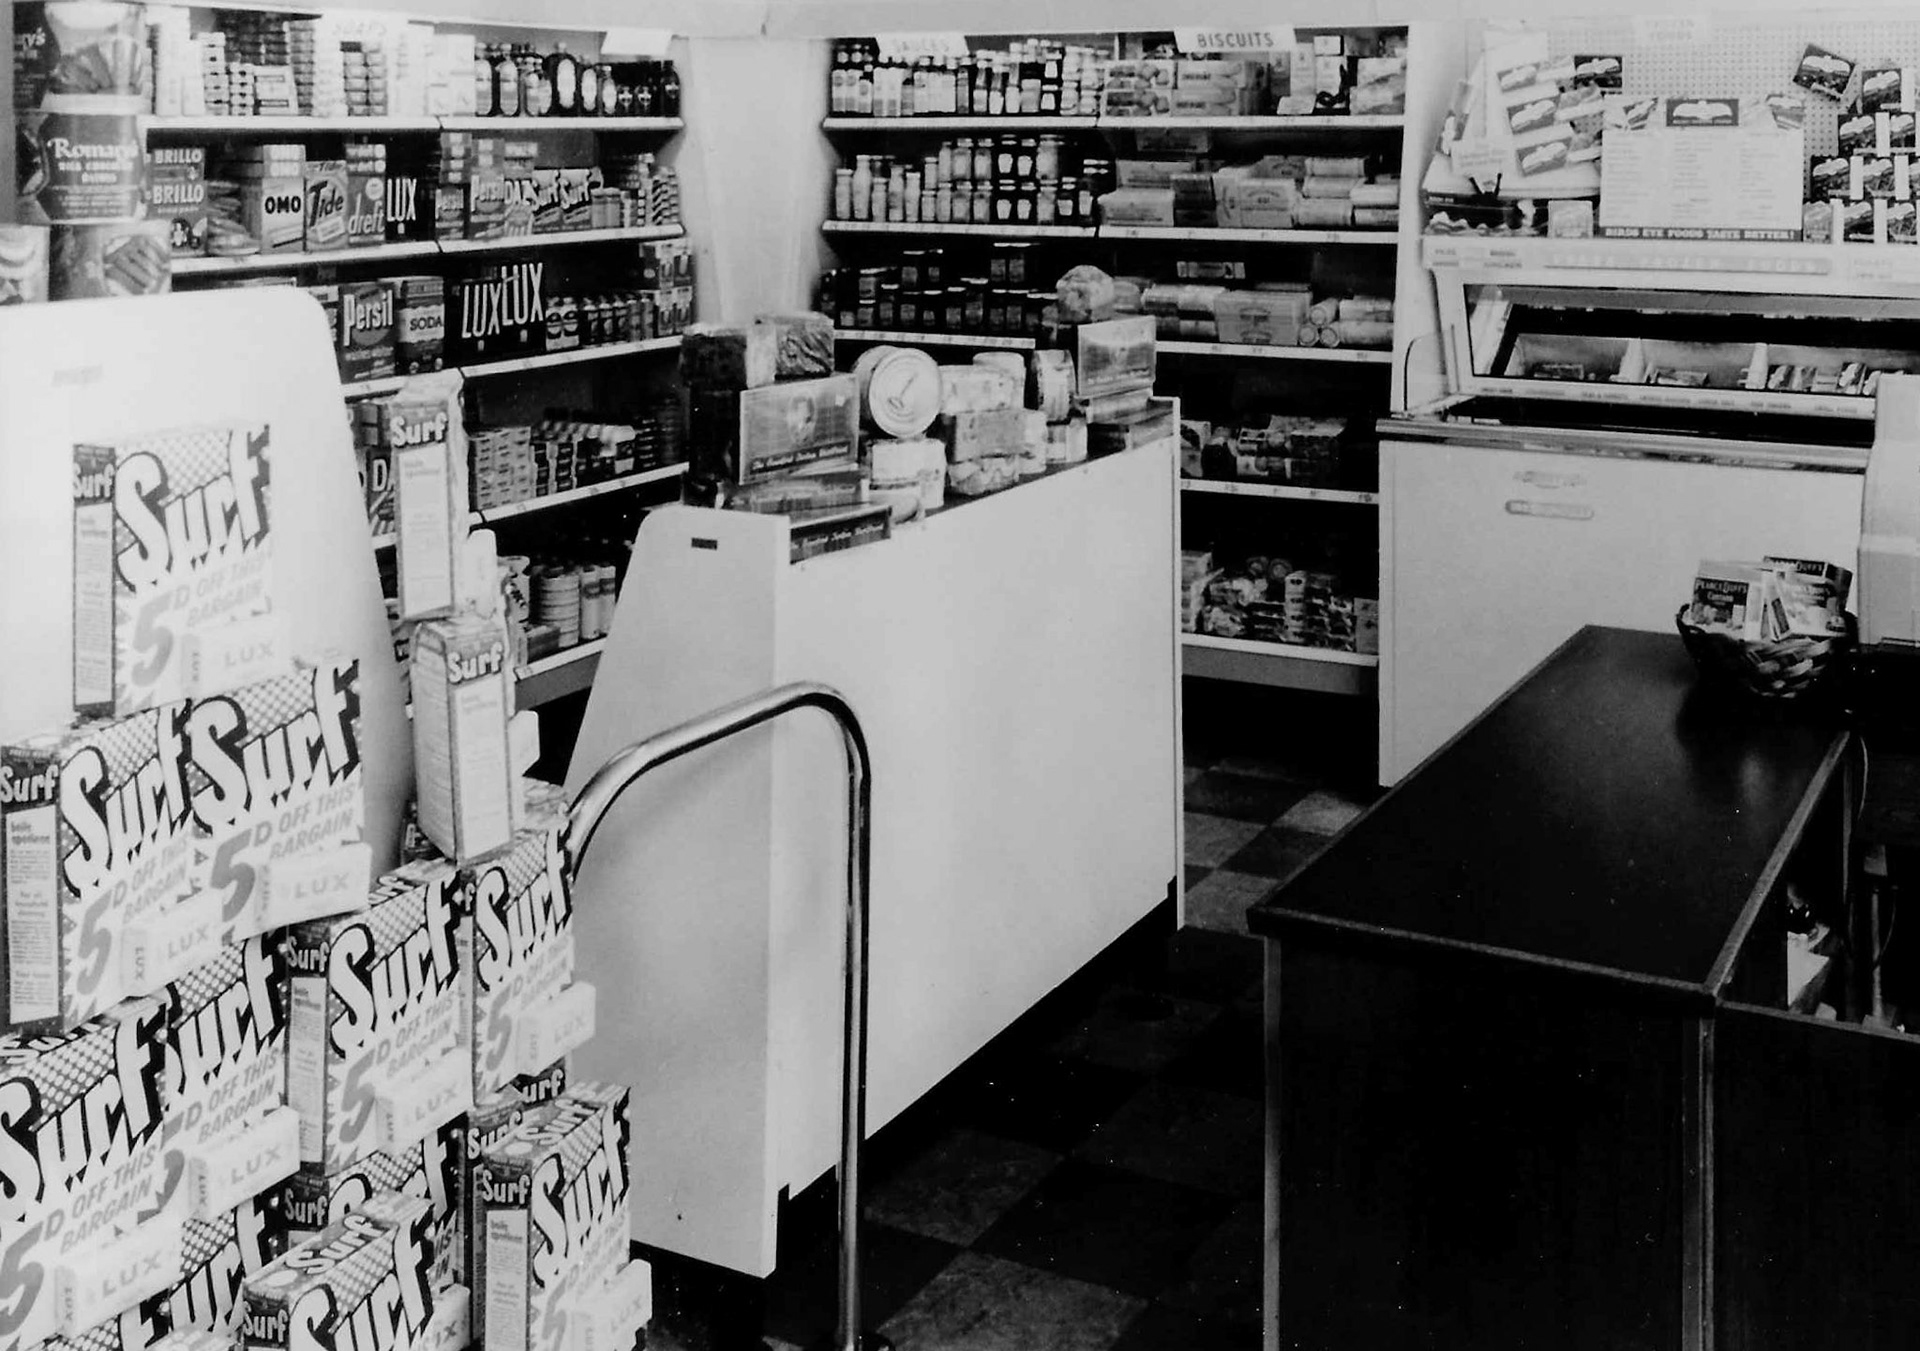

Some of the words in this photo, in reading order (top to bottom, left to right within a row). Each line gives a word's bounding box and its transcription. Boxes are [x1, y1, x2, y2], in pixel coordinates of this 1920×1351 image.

[1197, 31, 1274, 49] BISCUITS
[155, 149, 202, 163] BRILLO
[153, 183, 204, 204] BRILLO
[264, 196, 301, 214] OMO
[309, 180, 344, 227] Tide
[387, 178, 417, 221] LUX
[560, 170, 591, 210] Surf
[349, 193, 385, 234] dreft
[1605, 228, 1639, 238] BIRDS
[1642, 228, 1664, 238] EYE
[1667, 229, 1703, 239] FOODS
[1706, 229, 1741, 239] TASTE
[1744, 230, 1795, 240] BETTER!
[462, 283, 501, 339] LUX
[501, 262, 543, 326] LUX
[343, 289, 393, 347] Persil
[409, 316, 444, 331] SODA
[391, 412, 447, 447] Surf
[73, 463, 115, 500] Surf
[115, 423, 269, 594] Surf
[224, 642, 273, 668] LUX
[450, 642, 504, 683] Surf
[189, 658, 362, 838] Surf
[0, 765, 58, 803] Surf
[61, 698, 192, 899] Surf
[279, 800, 311, 833] OFF
[316, 782, 358, 817] THIS
[269, 808, 354, 860] BARGAIN
[295, 872, 349, 899] LUX
[471, 824, 574, 993] Surf
[168, 923, 209, 959] LUX
[286, 935, 330, 973] Surf
[329, 870, 459, 1061] Surf
[209, 1074, 239, 1112] OFF
[243, 1046, 280, 1087] THIS
[522, 1069, 564, 1103] urf
[0, 1002, 166, 1222] Surf
[197, 1074, 276, 1144] BARGAIN
[515, 1098, 596, 1147] Surf
[71, 1176, 110, 1219] OFF
[113, 1144, 158, 1191] THIS
[231, 1144, 282, 1185] LUX
[284, 1187, 328, 1226] Surf
[482, 1169, 531, 1205] Surf
[531, 1087, 632, 1290] Surf
[60, 1172, 153, 1255] BARGAIN
[285, 1215, 383, 1276] Surf
[103, 1250, 162, 1298] LUX
